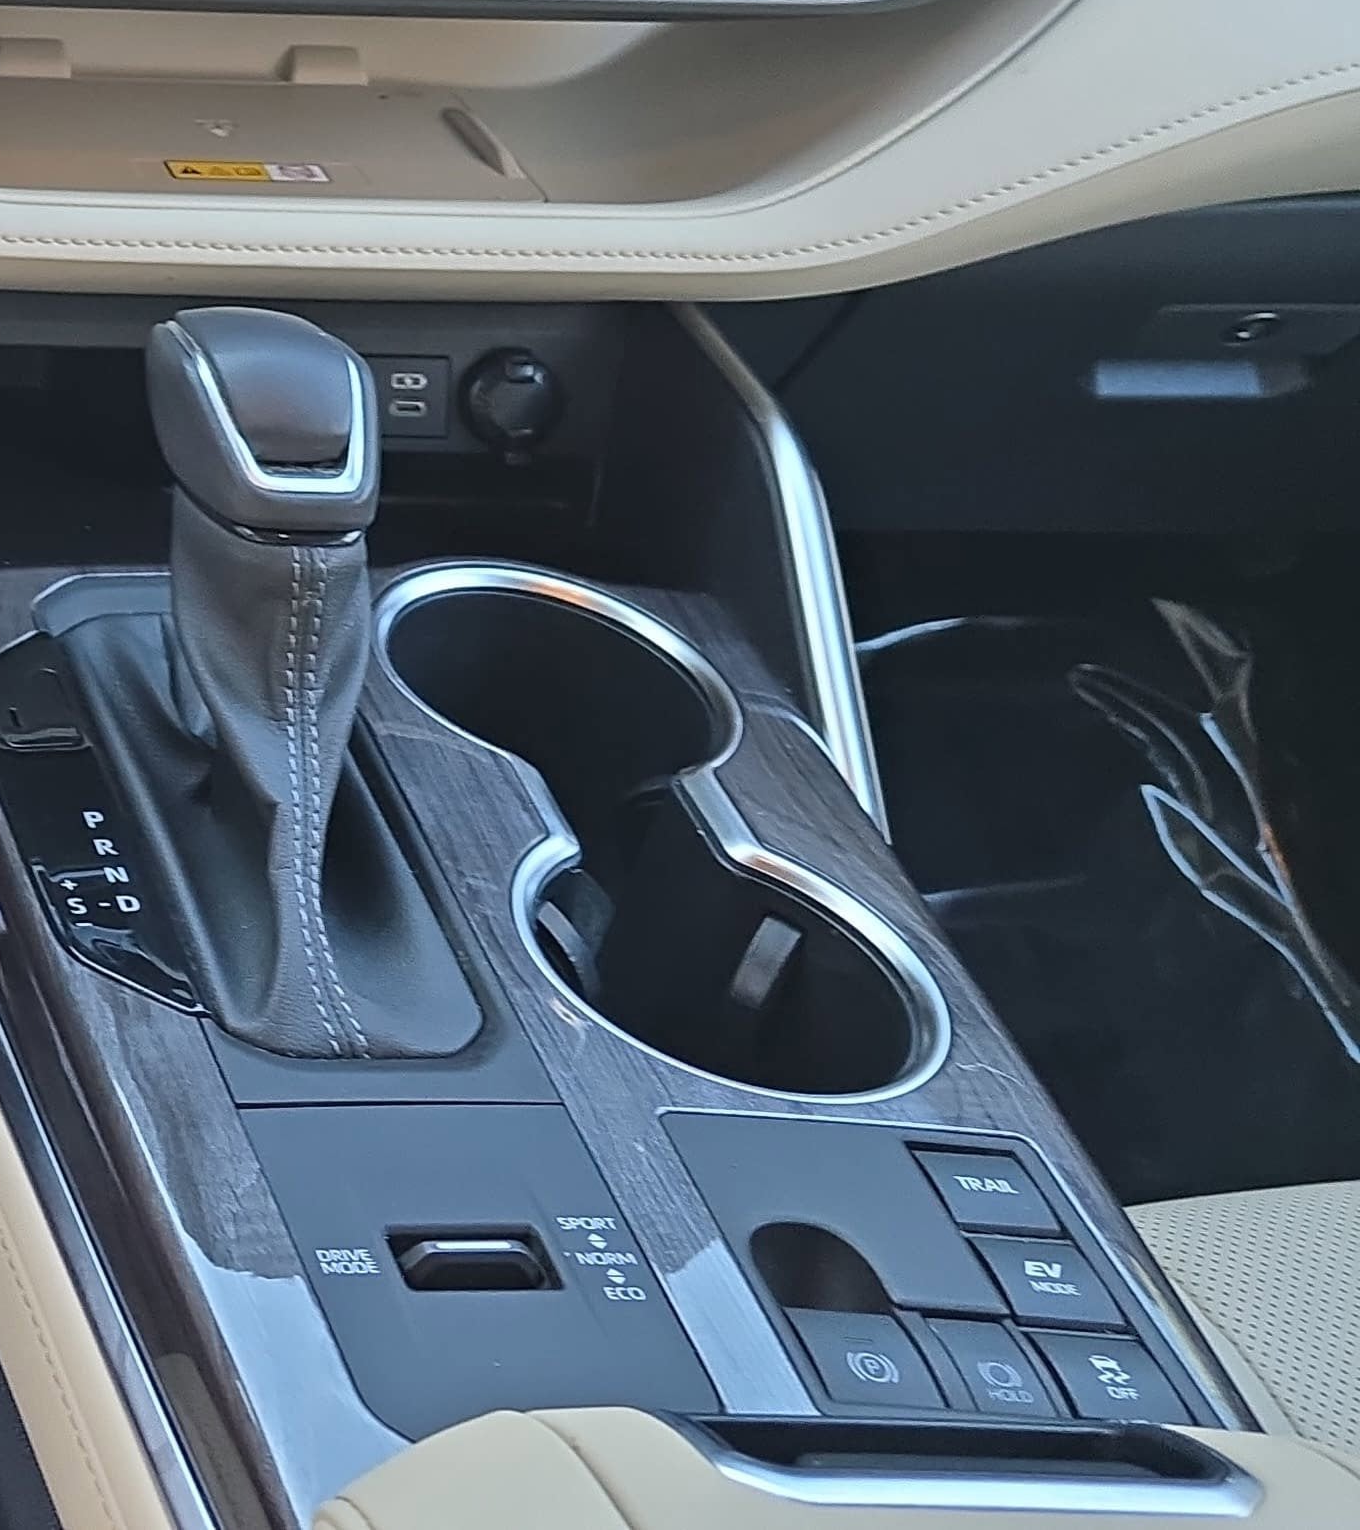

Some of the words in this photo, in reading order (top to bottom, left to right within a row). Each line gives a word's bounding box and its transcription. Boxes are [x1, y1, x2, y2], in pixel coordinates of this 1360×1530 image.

[83, 811, 104, 829] P
[93, 838, 119, 856] R
[103, 867, 130, 884] N
[116, 895, 141, 912] D
[953, 1175, 1021, 1196] TRAIL
[556, 1215, 619, 1232] SPORT
[315, 1248, 373, 1263] DRIVE
[575, 1251, 639, 1267] NORM
[323, 1260, 381, 1276] MODE
[1024, 1260, 1063, 1279] EV
[603, 1285, 648, 1302] ECO
[1029, 1279, 1082, 1297] MODE
[989, 1388, 1035, 1404] HOLD
[1106, 1386, 1139, 1402] OFF
